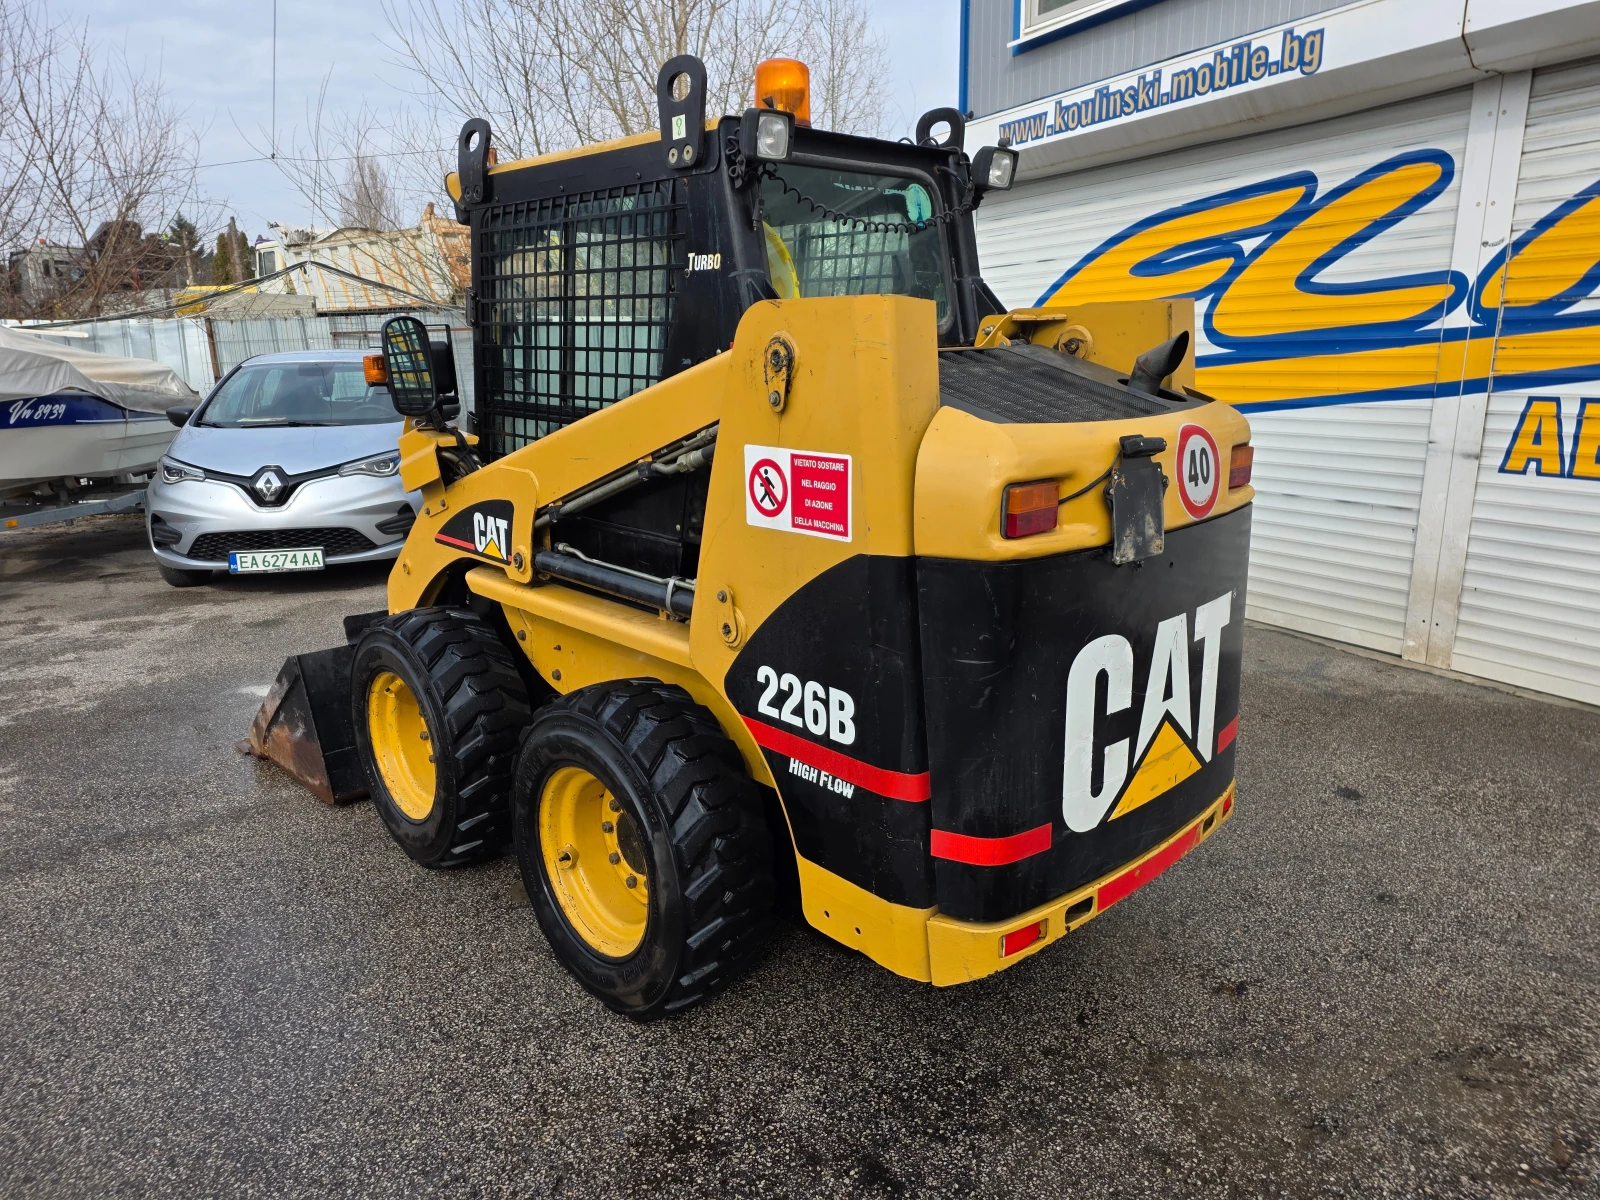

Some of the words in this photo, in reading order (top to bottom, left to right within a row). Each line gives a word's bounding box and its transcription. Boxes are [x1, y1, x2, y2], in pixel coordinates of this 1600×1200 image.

[999, 27, 1325, 146] www.koulinski.mobile.bg
[794, 458, 816, 468] VIETATO
[817, 461, 844, 471] SOSTARE
[801, 479, 813, 487] NEL
[813, 480, 836, 491] RAGGIO
[1188, 446, 1210, 488] 40
[794, 516, 812, 526] DELLA
[813, 519, 844, 532] MACCHINA
[804, 498, 811, 507] DI
[811, 500, 833, 511] AZIONE
[473, 511, 508, 561] CAT
[239, 555, 259, 569] EA
[262, 553, 298, 567] 6274
[302, 552, 320, 565] AA
[756, 665, 856, 745] 226B
[1062, 590, 1232, 833] CAT
[788, 757, 818, 784] HIGH
[819, 769, 855, 799] FLOW
